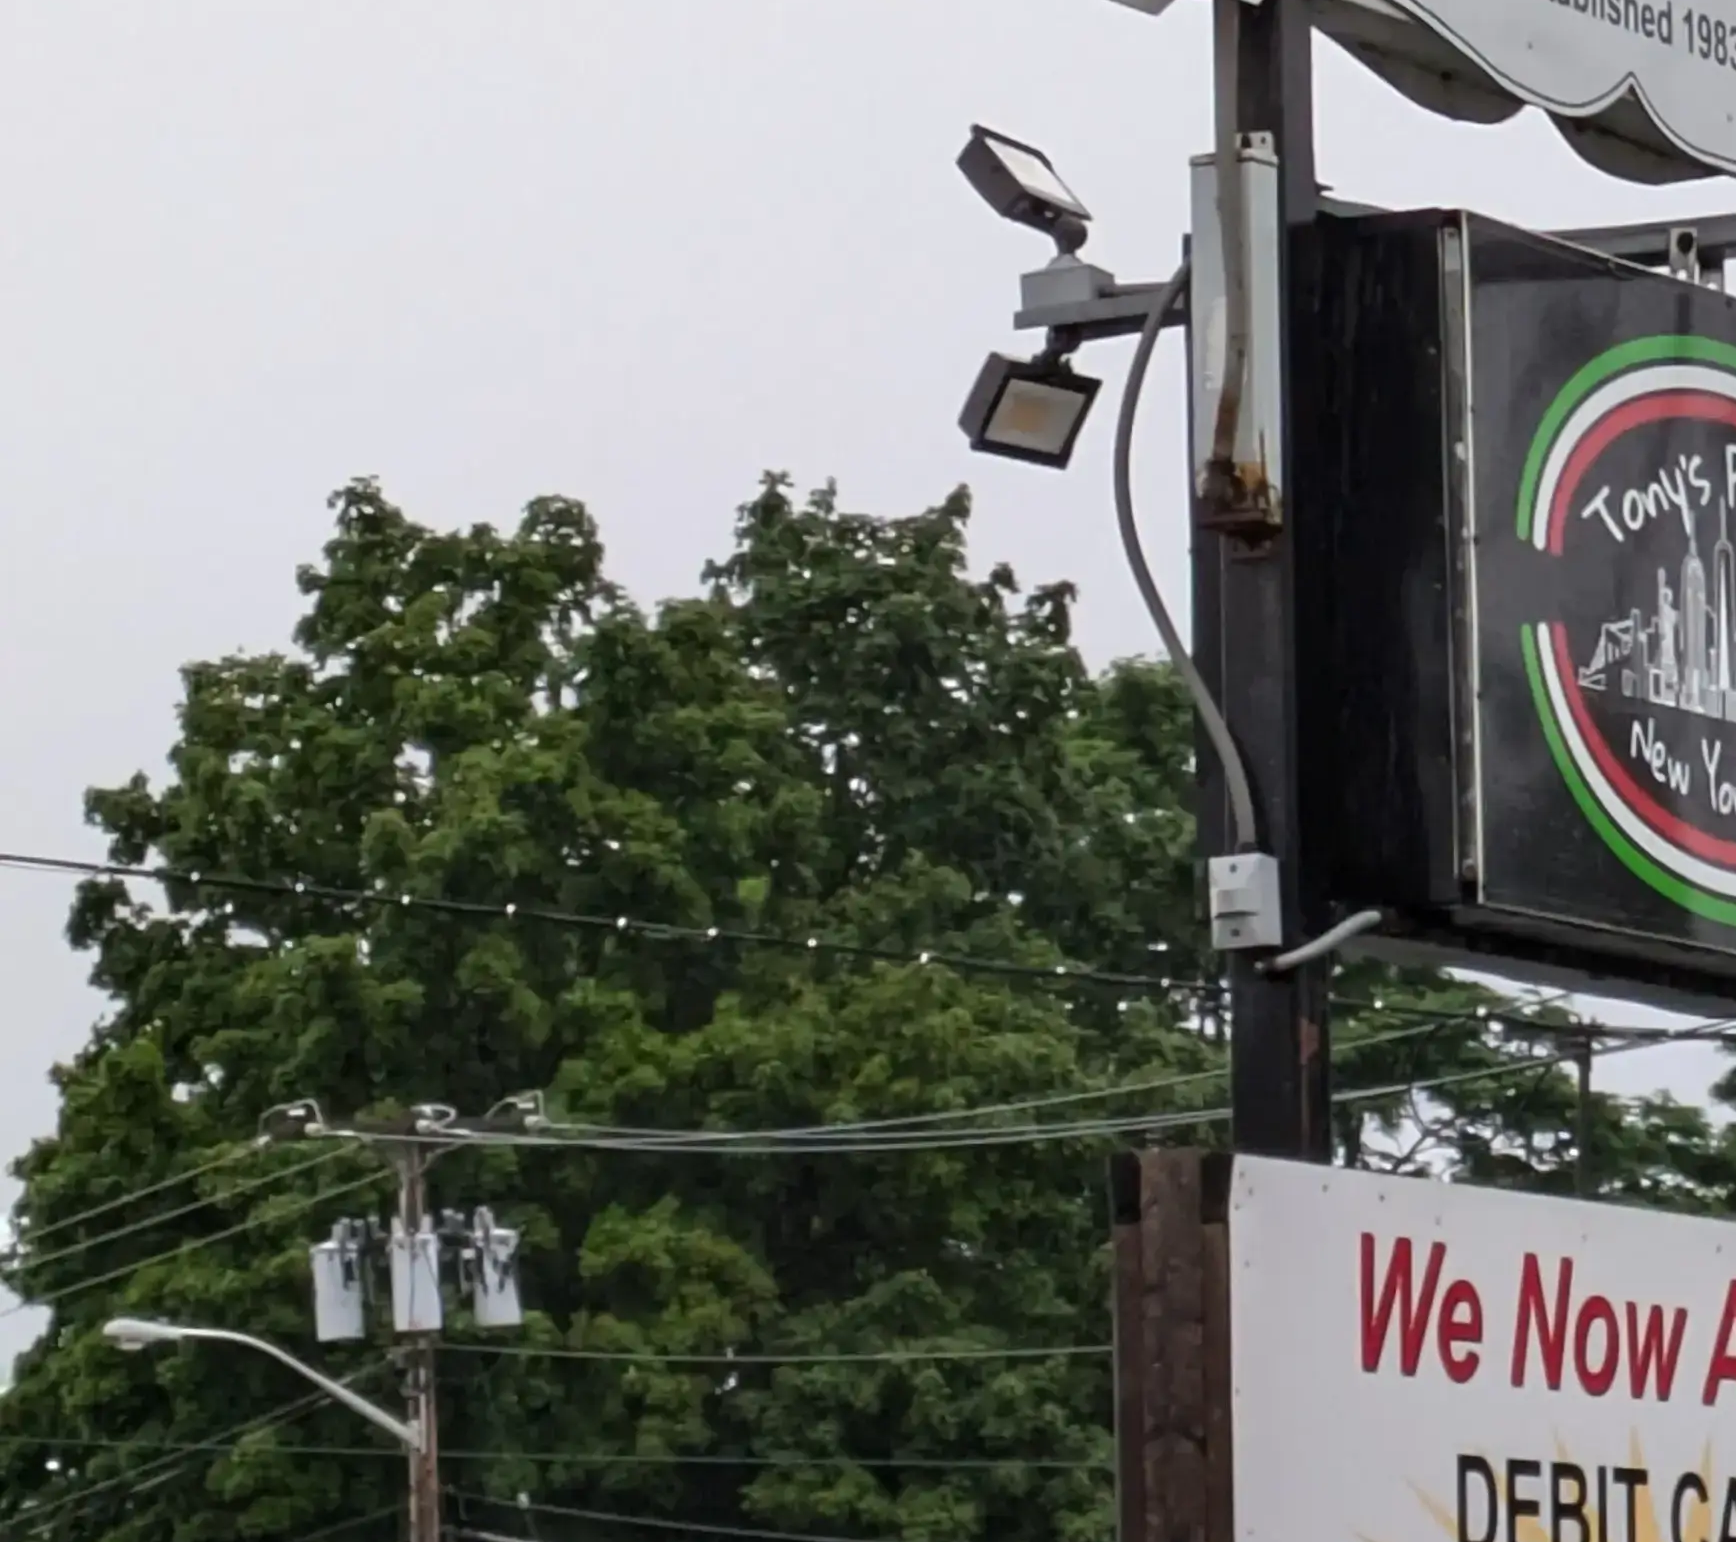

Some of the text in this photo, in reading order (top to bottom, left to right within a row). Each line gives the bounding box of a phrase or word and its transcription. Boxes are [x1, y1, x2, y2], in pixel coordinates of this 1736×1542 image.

[1580, 453, 1712, 543] Tony's
[1629, 716, 1691, 796] New
[1359, 1232, 1484, 1382] We
[1511, 1252, 1687, 1400] Now
